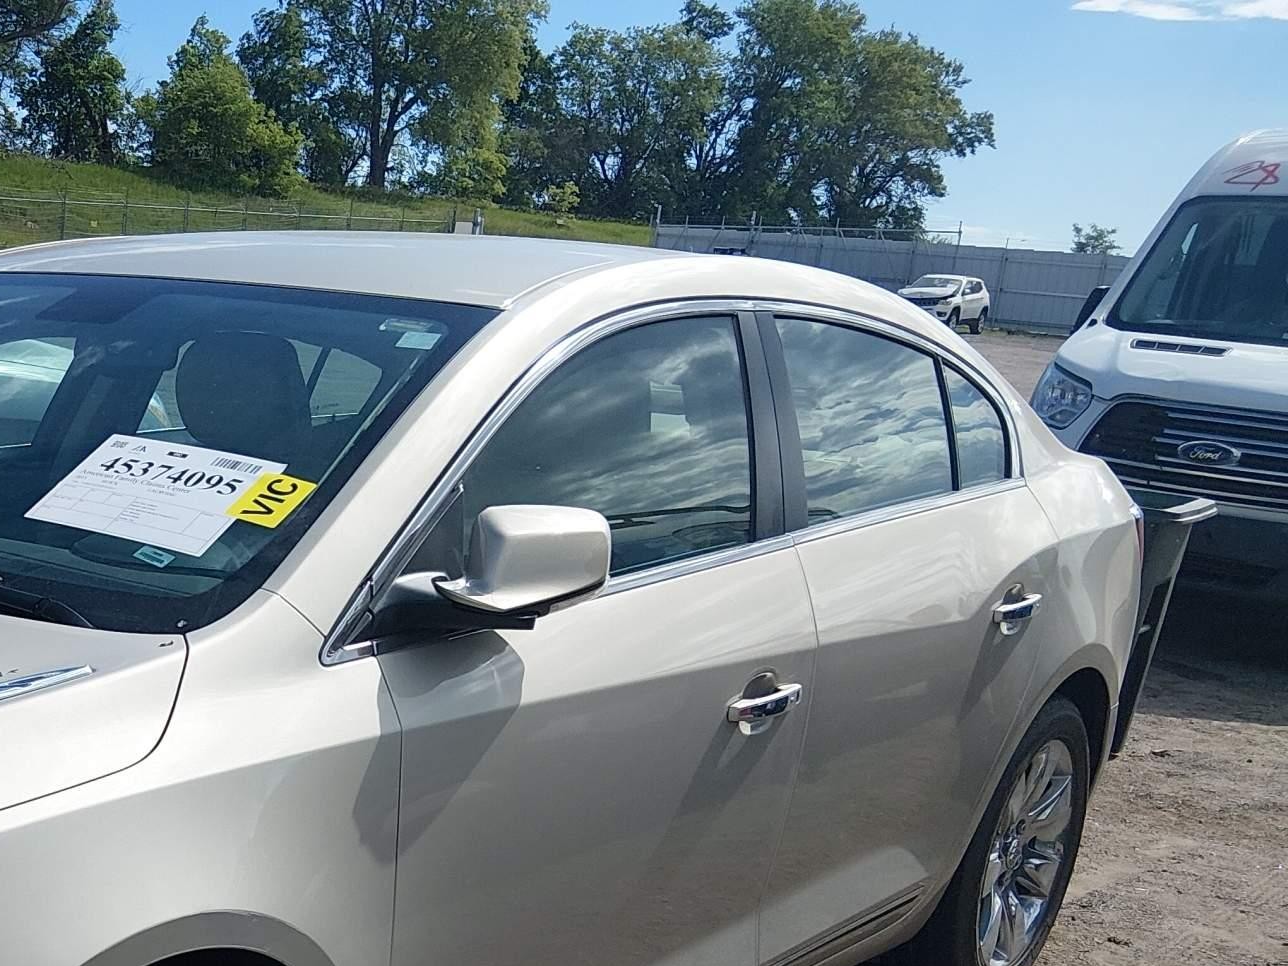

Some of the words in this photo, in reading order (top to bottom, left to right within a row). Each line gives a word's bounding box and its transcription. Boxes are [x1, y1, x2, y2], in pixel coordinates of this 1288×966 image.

[1189, 446, 1223, 460] Ford
[100, 456, 244, 496] 45374095
[239, 478, 299, 516] VIC
